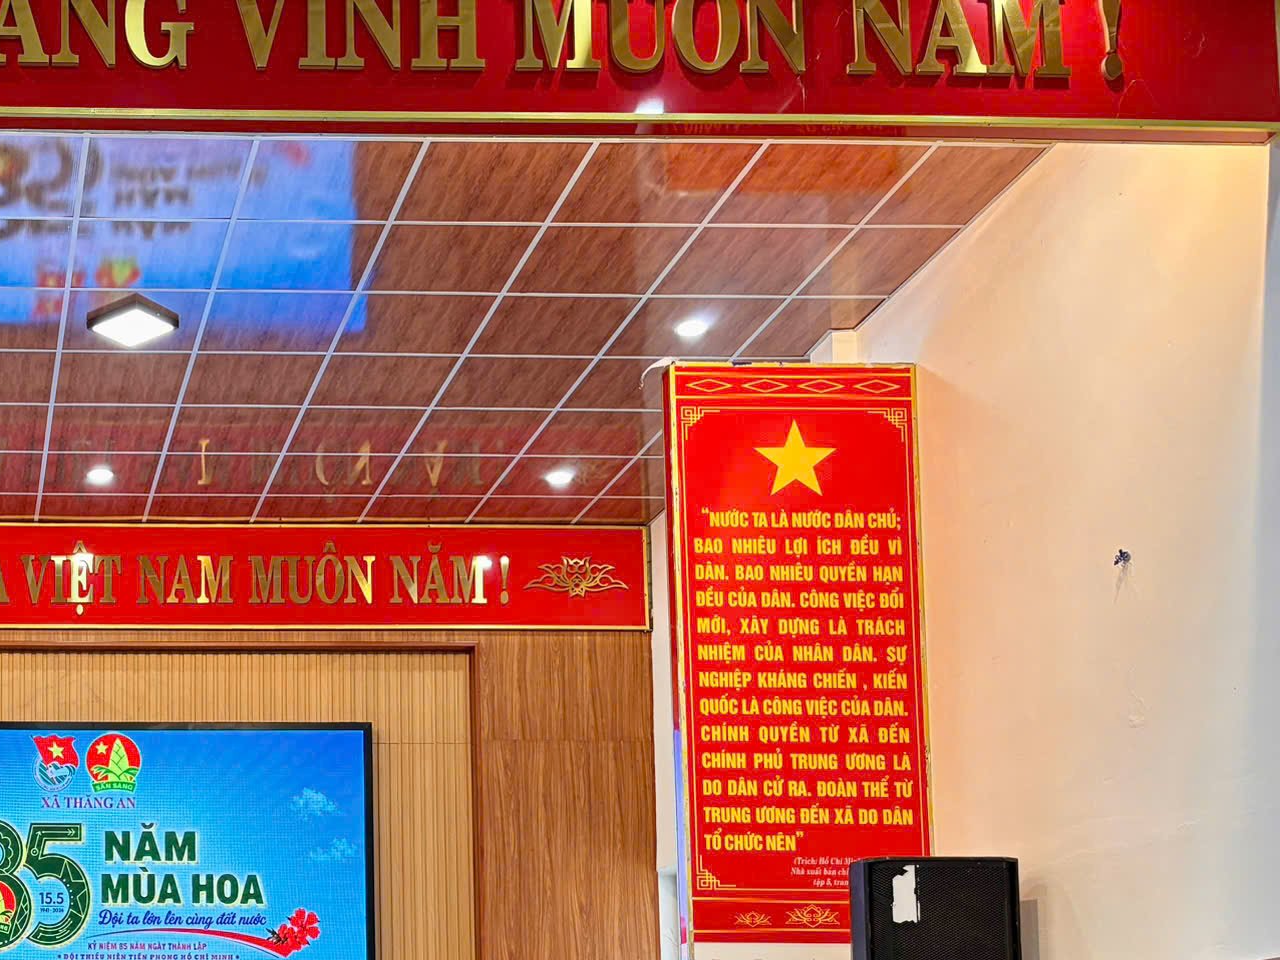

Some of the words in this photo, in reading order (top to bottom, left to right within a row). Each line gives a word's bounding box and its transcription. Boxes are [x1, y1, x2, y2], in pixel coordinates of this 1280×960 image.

[236, 0, 486, 70] VINH
[752, 512, 769, 528] TA
[771, 510, 788, 528] LÀ
[792, 509, 831, 528] NƯỚC
[867, 508, 901, 531] CHỦ;
[20, 540, 120, 615] VIỆT
[137, 555, 233, 605] NAM
[248, 540, 375, 605] MUÔN
[390, 544, 490, 605] NĂM
[695, 561, 729, 580] DÂN.
[735, 565, 763, 580] BAO
[770, 562, 813, 581] NHIÊU
[819, 561, 866, 583] QUYỀN
[873, 566, 903, 585] HẠN
[697, 615, 731, 635] MỚI,
[739, 615, 769, 635] XÂY
[778, 618, 820, 638] DỰNG
[829, 616, 847, 635] LÀ
[856, 616, 905, 636] TRÁCH
[701, 723, 749, 742] CHÍNH
[759, 722, 810, 744] QUYỀN
[820, 726, 840, 742] TỪ
[848, 724, 869, 743] XÃ
[879, 722, 910, 743] ĐẾN
[702, 749, 746, 769] CHÍNH
[754, 748, 783, 770] PHỦ
[790, 754, 838, 770] TRUNG
[846, 754, 886, 771] ƯƠNG
[894, 752, 911, 771] LÀ
[41, 795, 60, 808] XÃ
[64, 794, 113, 808] THĂNG
[116, 797, 135, 808] AN
[105, 822, 196, 861] NĂM
[704, 829, 722, 850] TỔ
[724, 831, 763, 851] CHỨC
[101, 867, 181, 904] MÙA
[192, 874, 264, 904] HOA
[40, 892, 64, 905] 15.5
[99, 910, 123, 928] Đội
[127, 913, 140, 925] ta
[142, 911, 161, 925] lớn
[164, 910, 182, 925] lên
[186, 912, 212, 929] cùng
[216, 912, 236, 925] đất
[239, 913, 266, 925] nước
